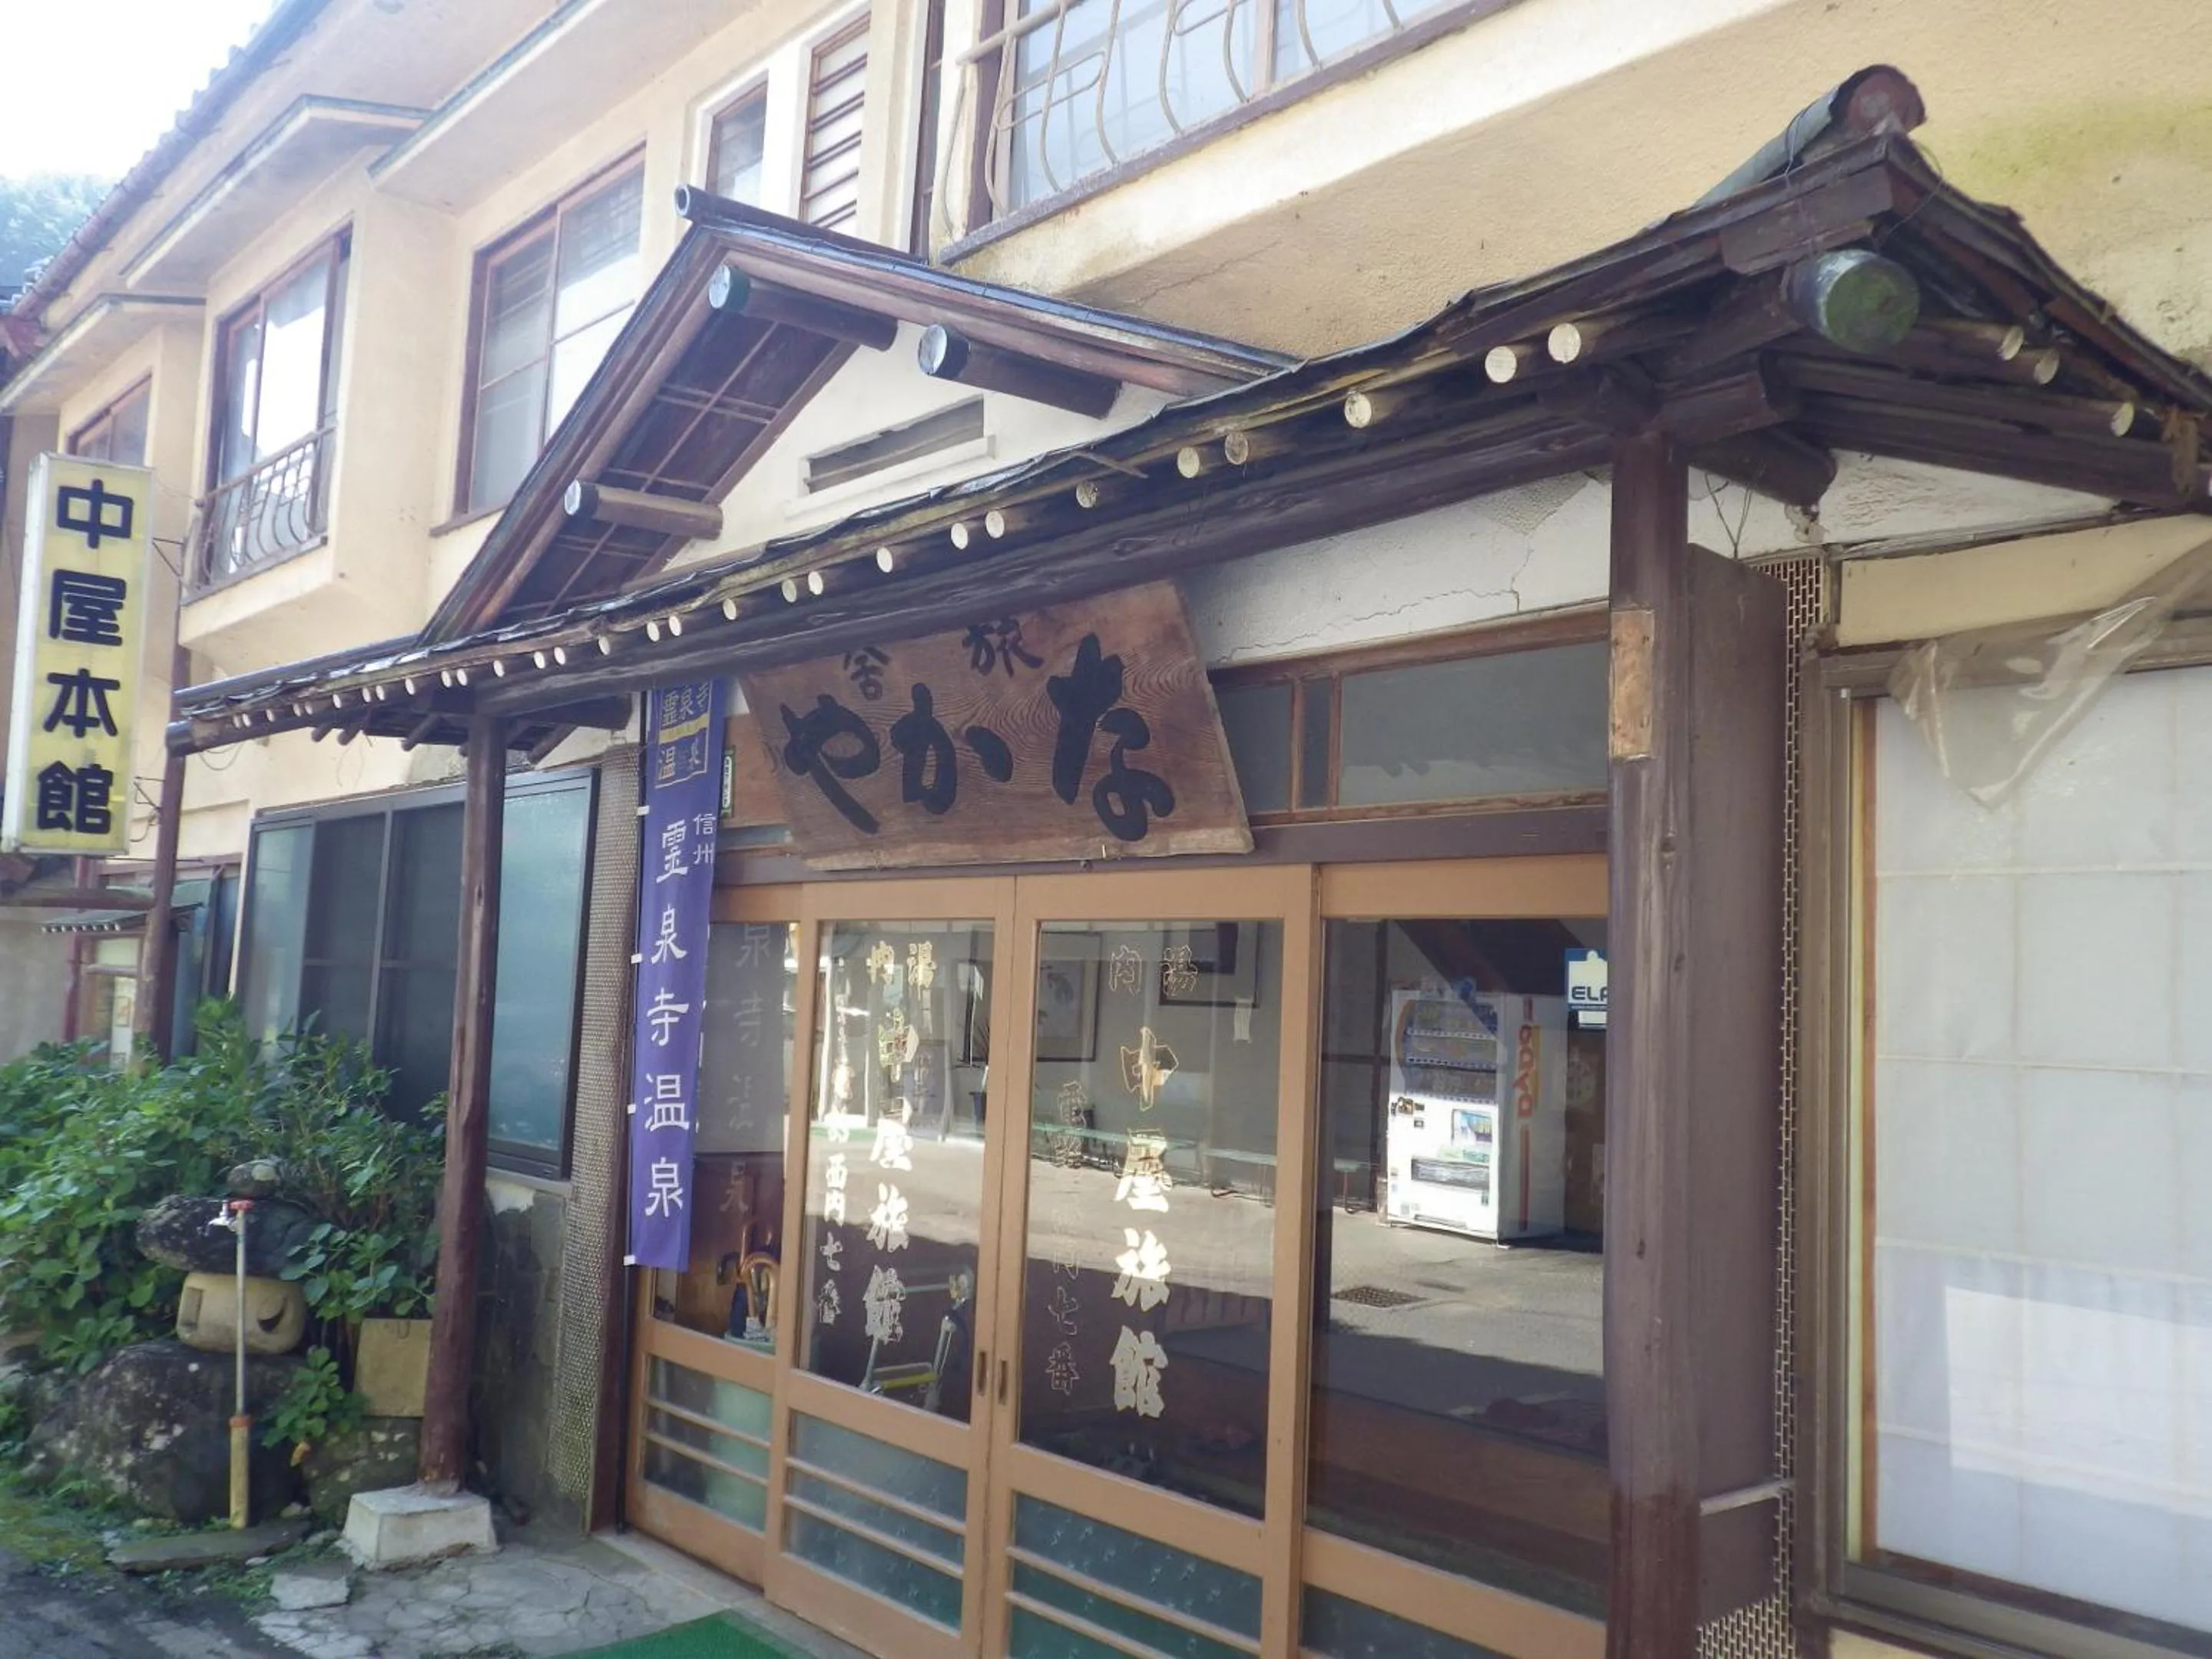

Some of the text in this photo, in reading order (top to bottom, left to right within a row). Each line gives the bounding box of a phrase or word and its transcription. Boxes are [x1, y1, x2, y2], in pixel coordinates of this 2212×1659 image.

[37, 478, 134, 835] 中屋本館
[781, 632, 1175, 841] なかや
[693, 813, 716, 866] 信州
[644, 820, 689, 1218] 霊泉寺温泉
[1110, 1026, 1179, 1418] 中屋旅館
